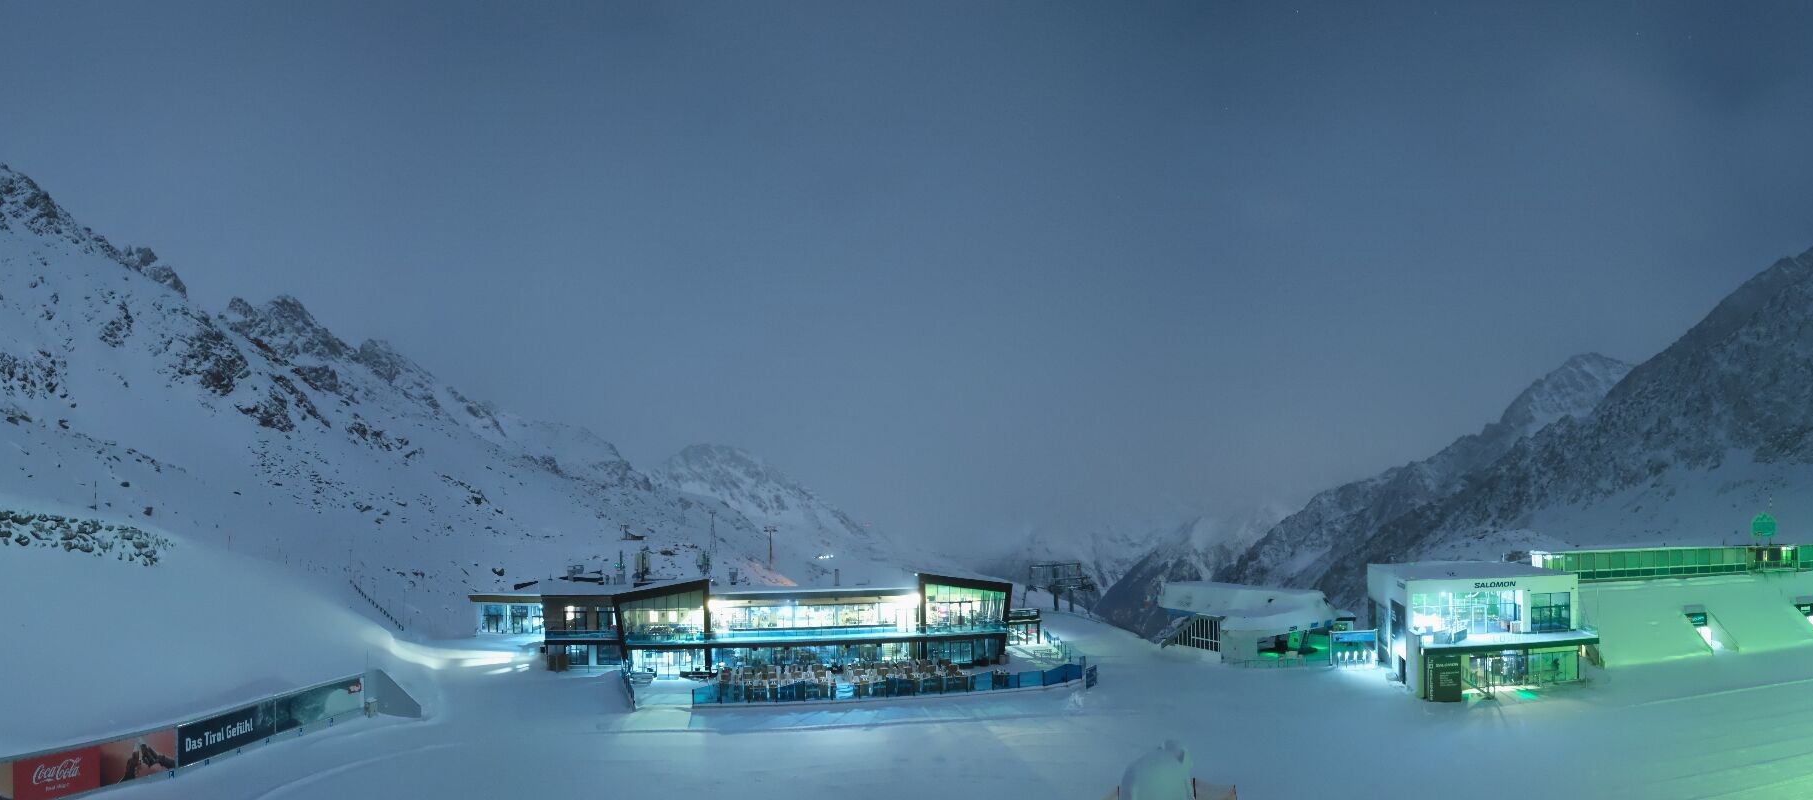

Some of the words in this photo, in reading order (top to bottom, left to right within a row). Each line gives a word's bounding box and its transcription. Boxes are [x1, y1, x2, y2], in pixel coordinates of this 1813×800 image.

[1474, 581, 1517, 589] SALOMON
[185, 737, 203, 753] Das
[204, 727, 225, 746] Tirol
[226, 718, 254, 739] Gefühl
